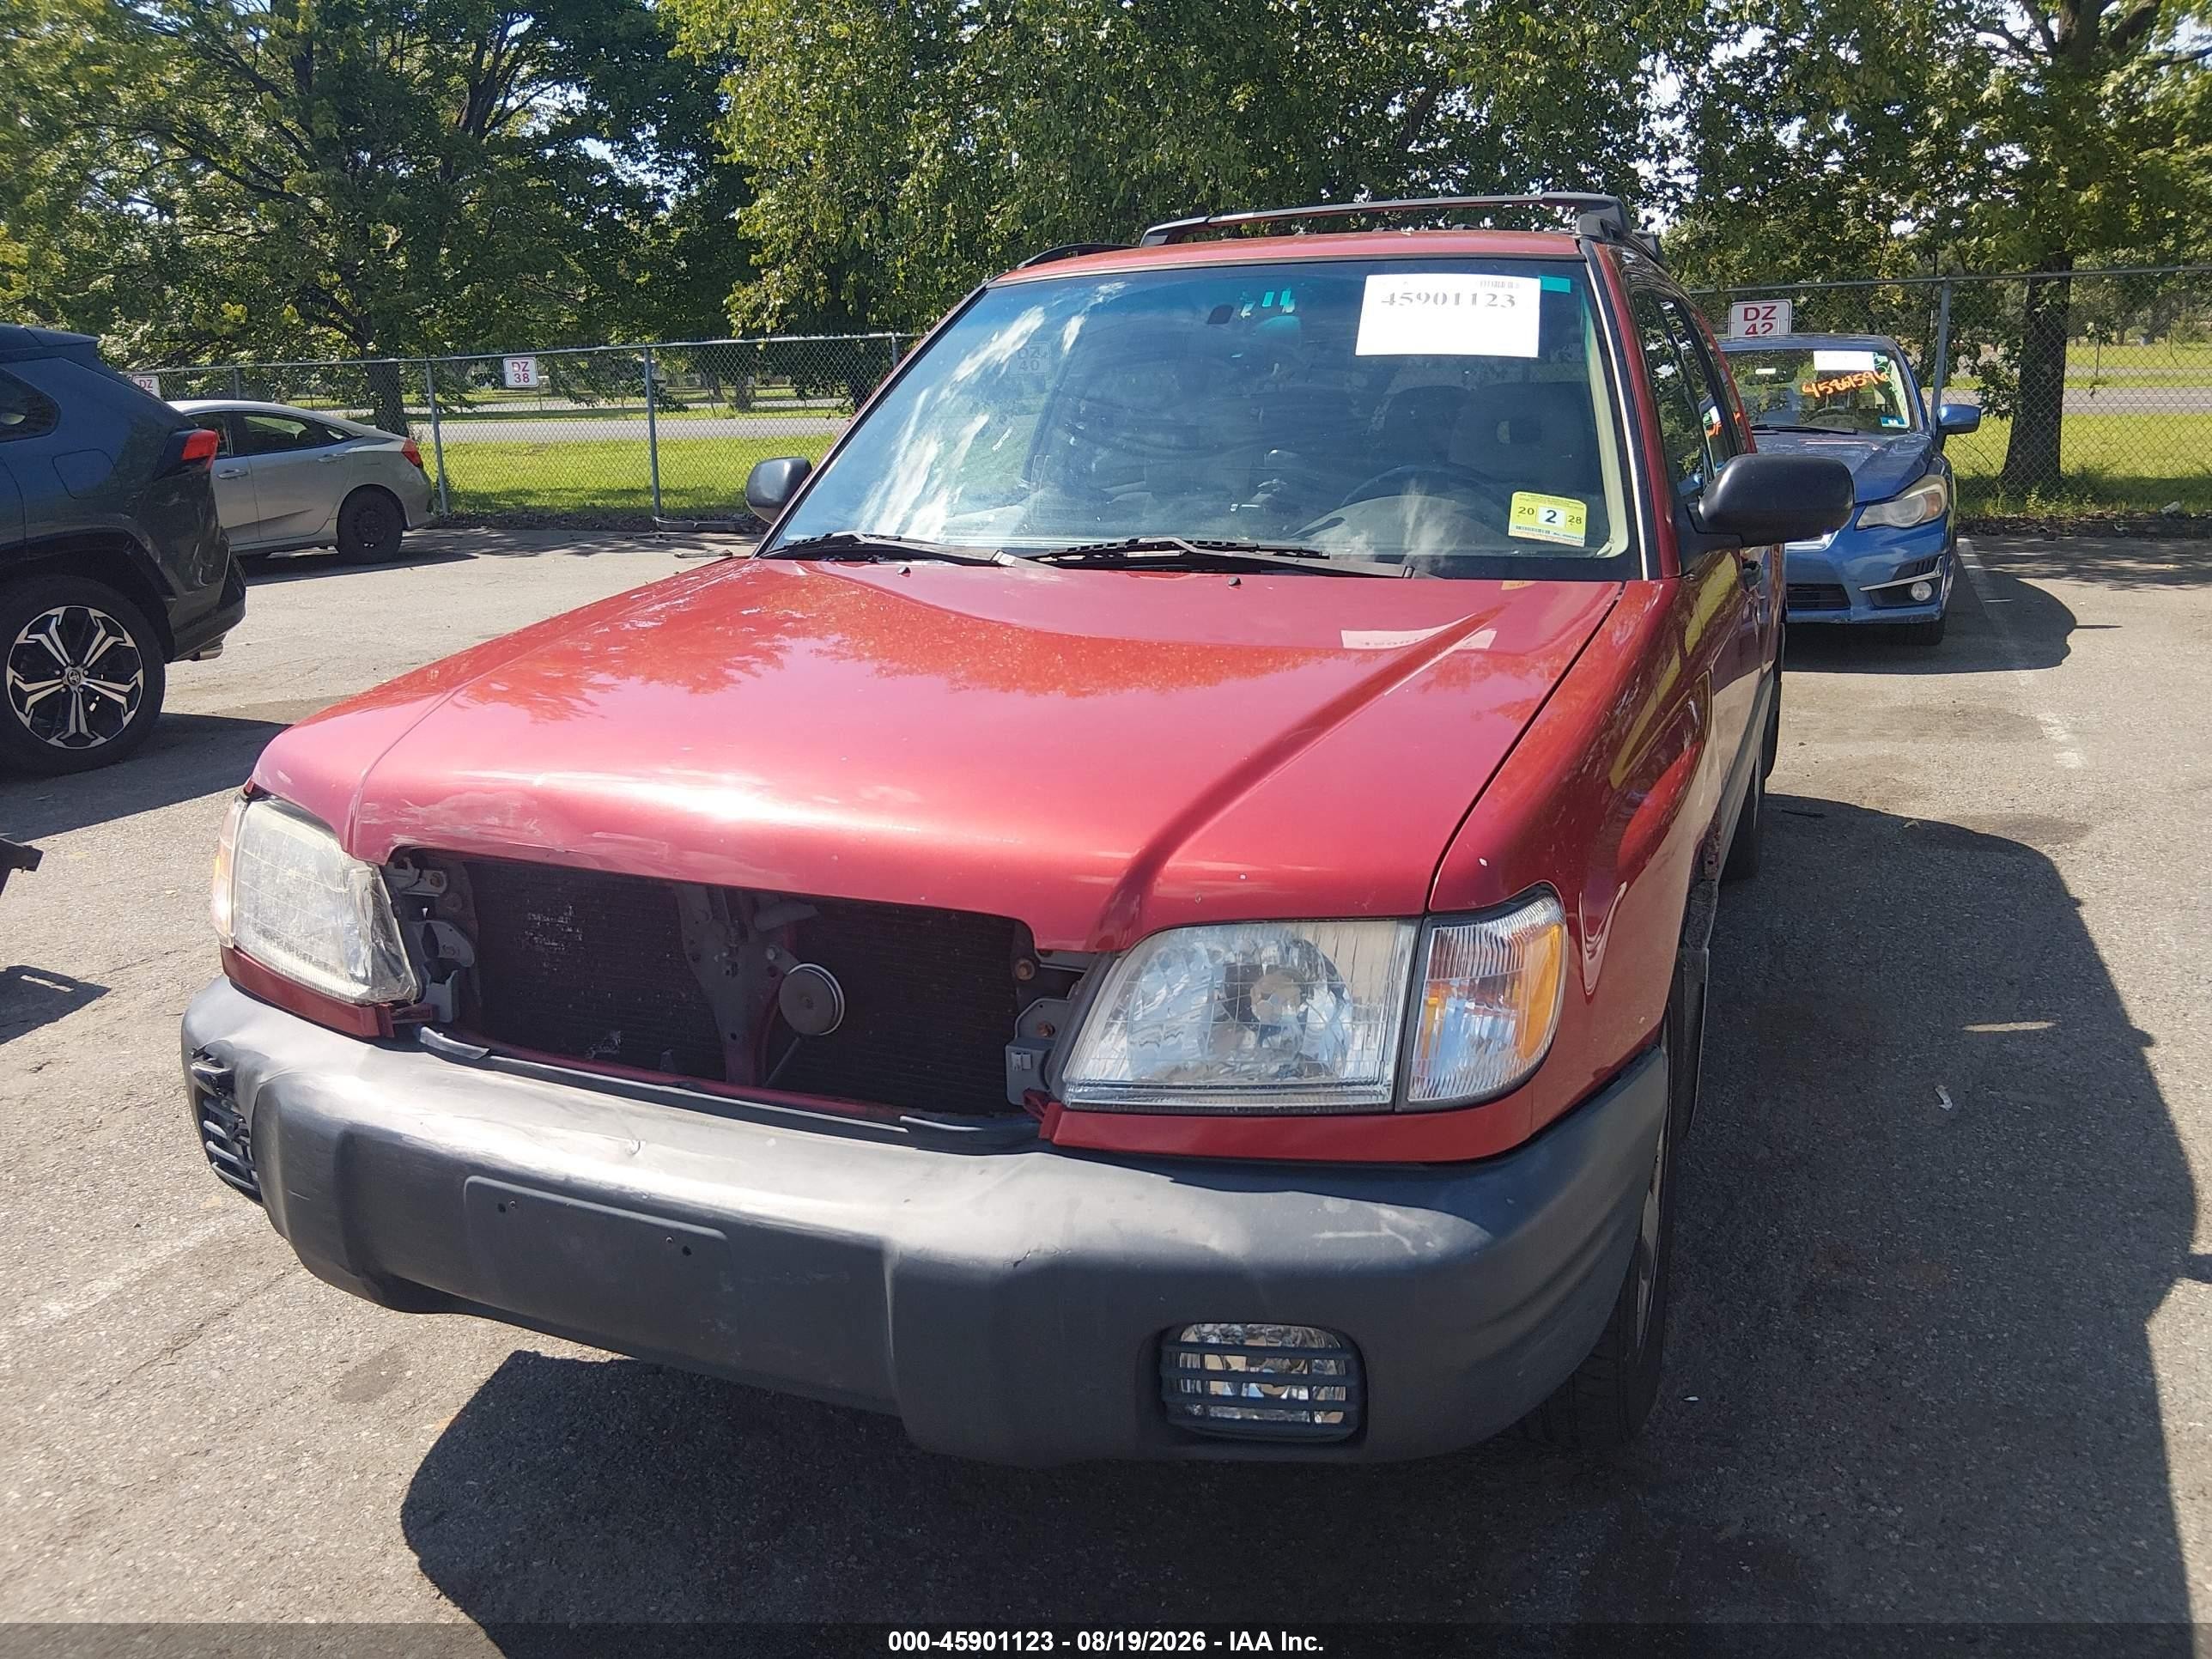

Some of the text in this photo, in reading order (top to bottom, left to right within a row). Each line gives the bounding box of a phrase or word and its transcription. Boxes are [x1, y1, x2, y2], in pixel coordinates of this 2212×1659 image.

[1381, 291, 1516, 308] 45901123
[1743, 305, 1778, 322] DZ
[1745, 322, 1774, 336] 42
[511, 361, 530, 372] DZ
[514, 373, 530, 383] 38
[139, 379, 153, 389] DZ
[1517, 507, 1535, 515] 20
[1545, 509, 1558, 524] 2
[1567, 515, 1583, 525] 28
